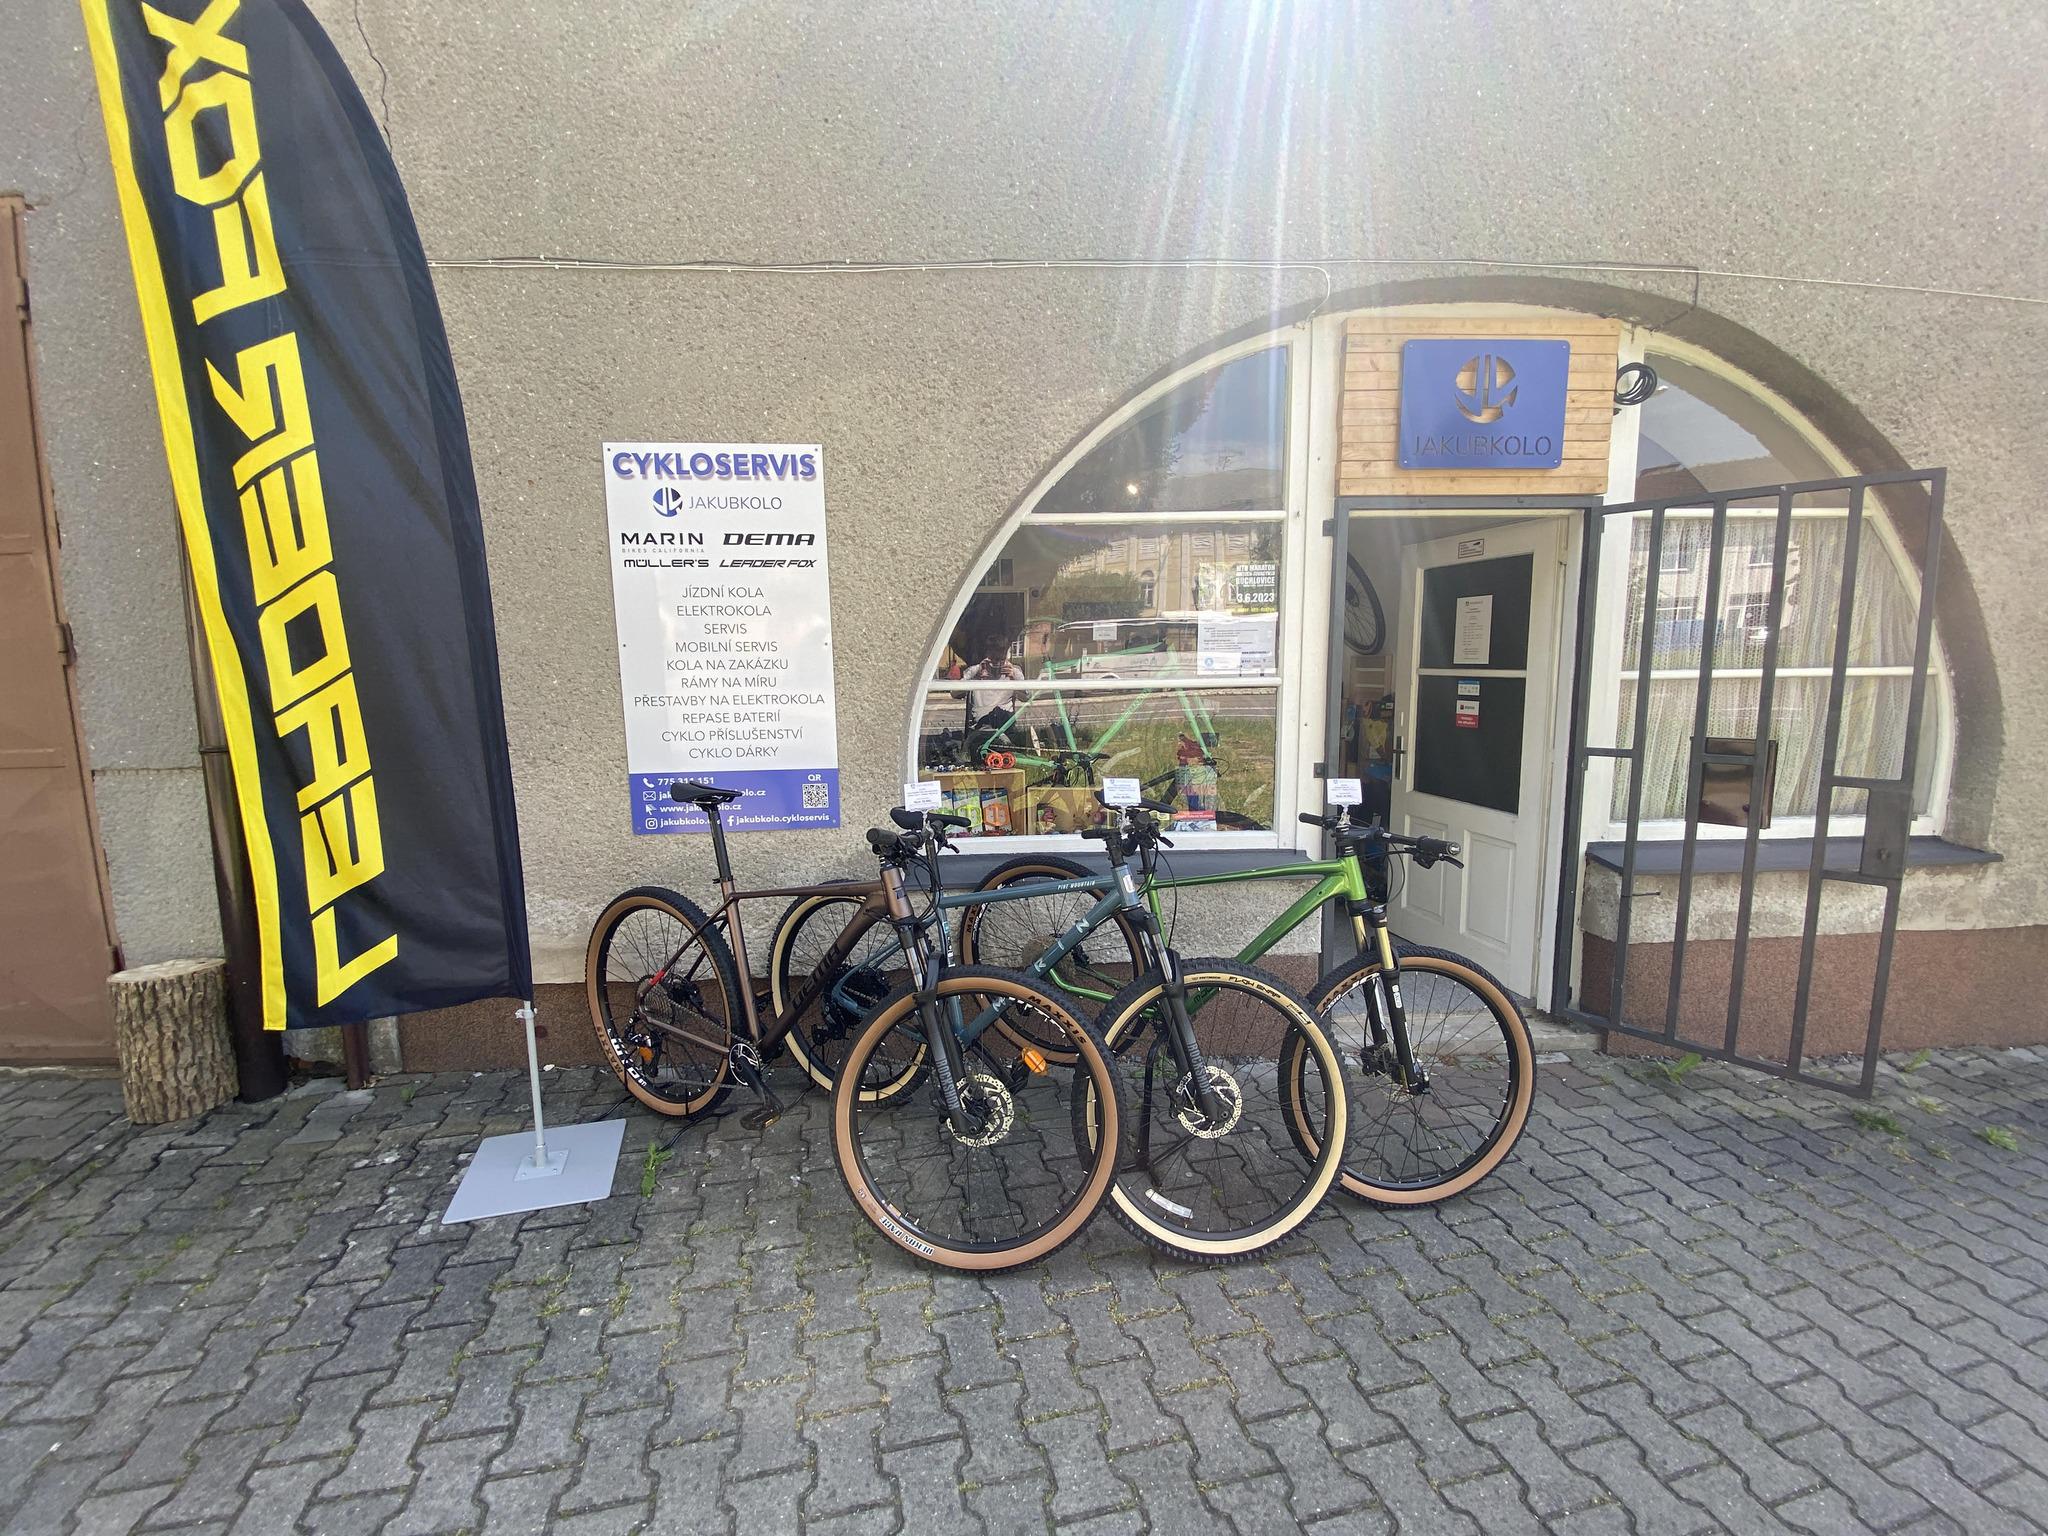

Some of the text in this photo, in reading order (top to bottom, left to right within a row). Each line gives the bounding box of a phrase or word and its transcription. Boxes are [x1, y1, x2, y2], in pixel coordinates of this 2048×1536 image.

[1413, 435, 1552, 456] JAKUBKOLO
[612, 452, 817, 478] CYKLOSERVIS
[141, 0, 399, 1006] LEADER FOX
[688, 496, 782, 510] JAKUBKOLO
[621, 532, 704, 545] MARIN
[723, 533, 815, 546] DEMA
[624, 559, 709, 568] MÜLLER'S
[719, 559, 817, 568] LEADER FOX
[682, 584, 764, 598] JÍZDNÍ KOLA
[1237, 592, 1275, 603] 3.6.2023
[676, 605, 772, 616] ELEKTROKOLA
[703, 623, 747, 635] SERVIS
[675, 639, 778, 653] MOBILNÍ SERVIS
[666, 657, 788, 671] KOLA NA ZAKÁZKU
[681, 674, 777, 688] RÁMY NA MÍRU
[634, 694, 825, 707] PŘESTAVBY NA ELEKTROKOLA
[682, 709, 780, 724] REPASE BATERIÍ
[661, 726, 803, 742] CYKLO PŘÍSLUŠENSTVÍ
[688, 745, 779, 759] CYKLO DÁRKY
[658, 777, 675, 786] 775
[698, 776, 714, 784] 151
[807, 774, 822, 782] QR
[735, 813, 830, 825] jakubkolo.cykloservis
[1027, 995, 1087, 1044] MAXXIS
